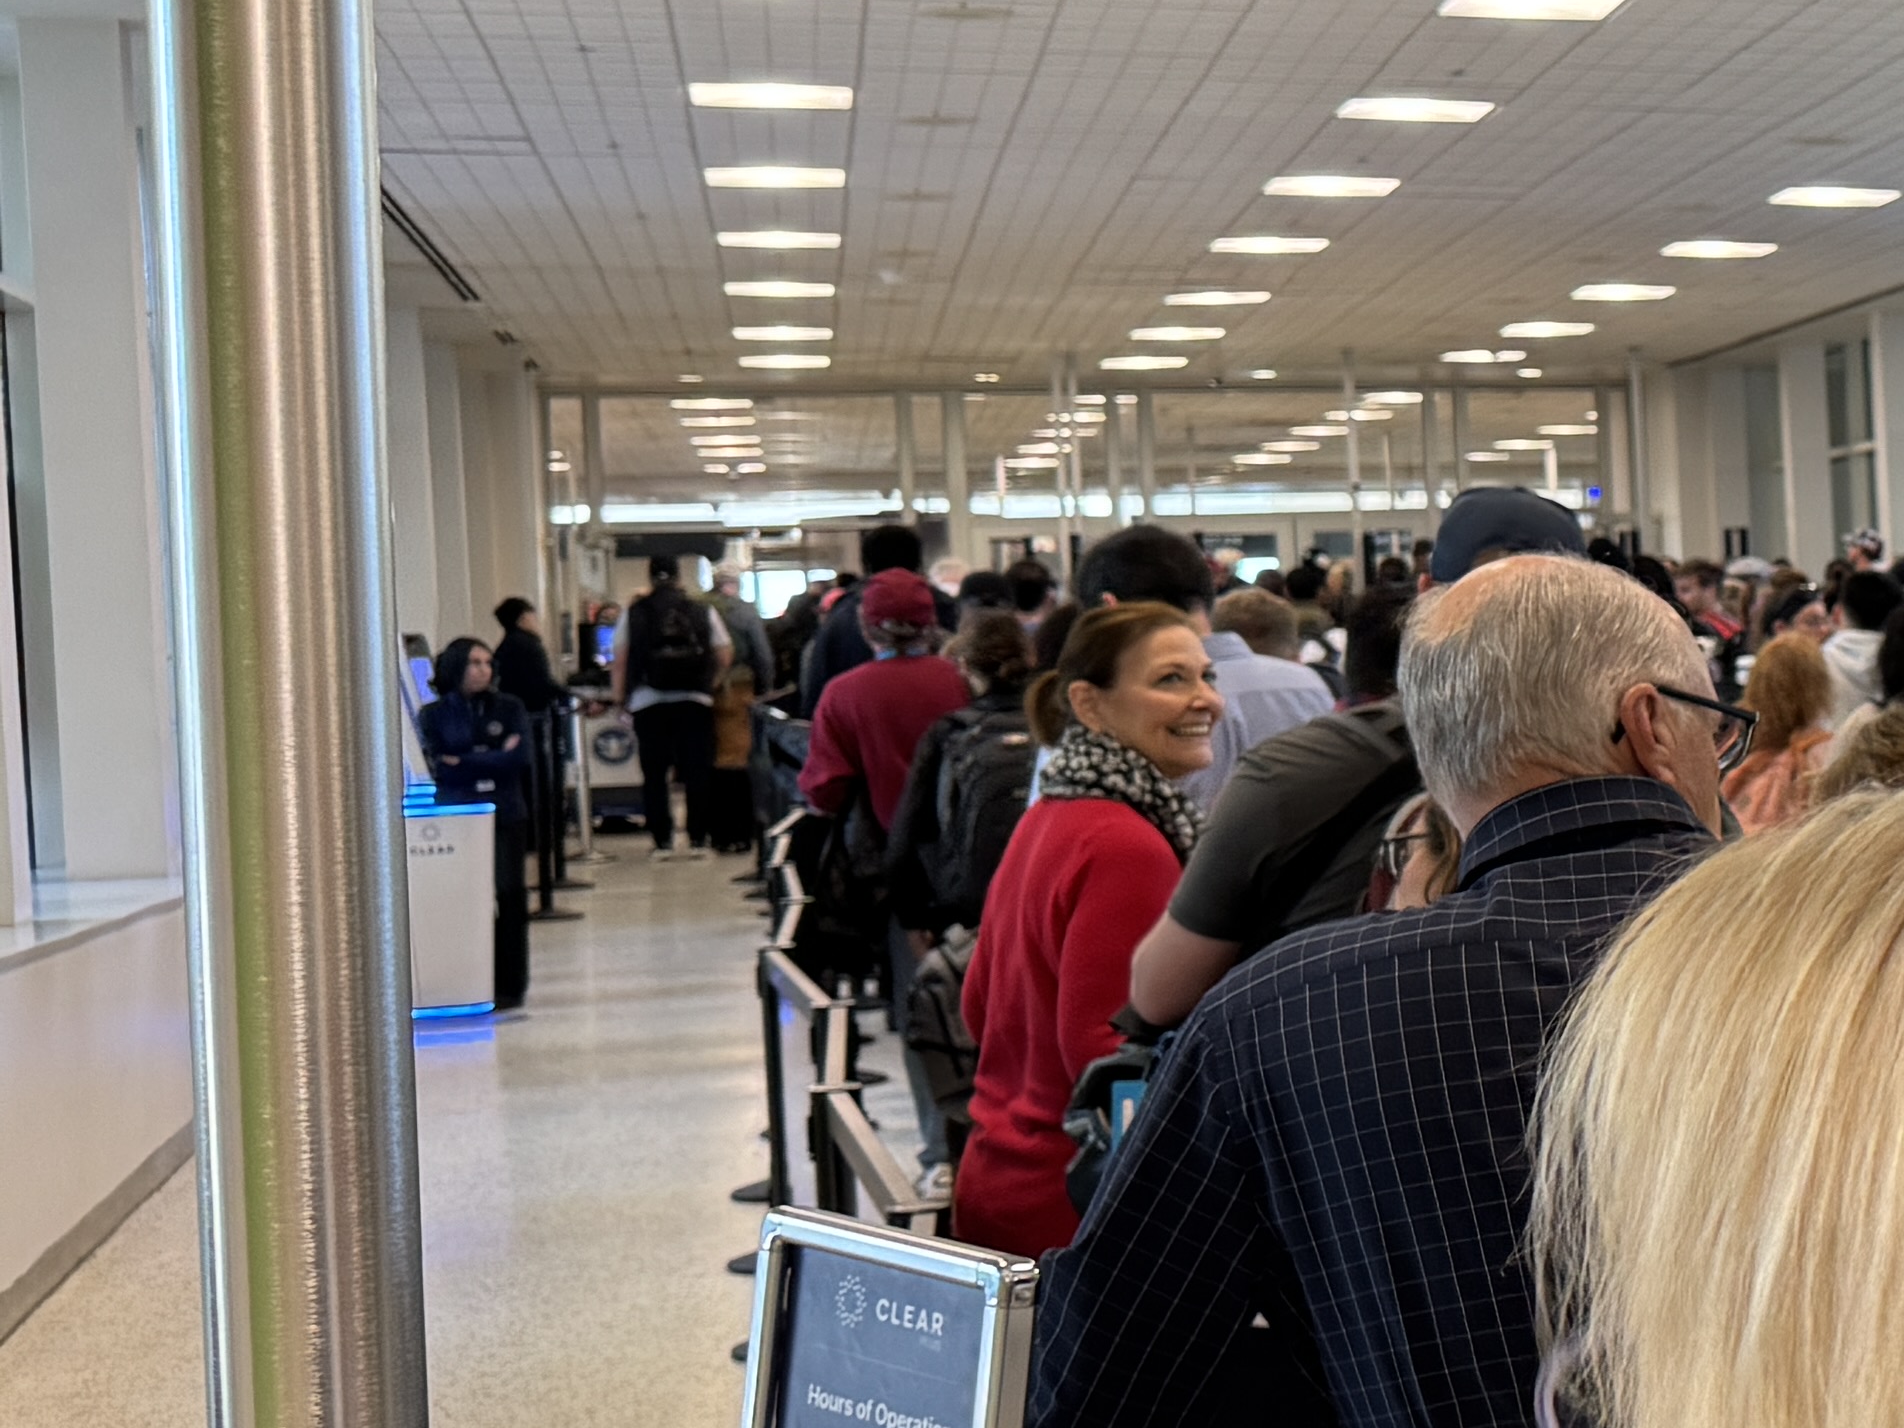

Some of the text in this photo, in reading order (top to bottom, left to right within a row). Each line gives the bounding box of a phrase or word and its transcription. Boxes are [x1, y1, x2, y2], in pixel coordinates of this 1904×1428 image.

[875, 1297, 944, 1337] CLEAR
[807, 1383, 853, 1416] Hours
[855, 1398, 875, 1422] of
